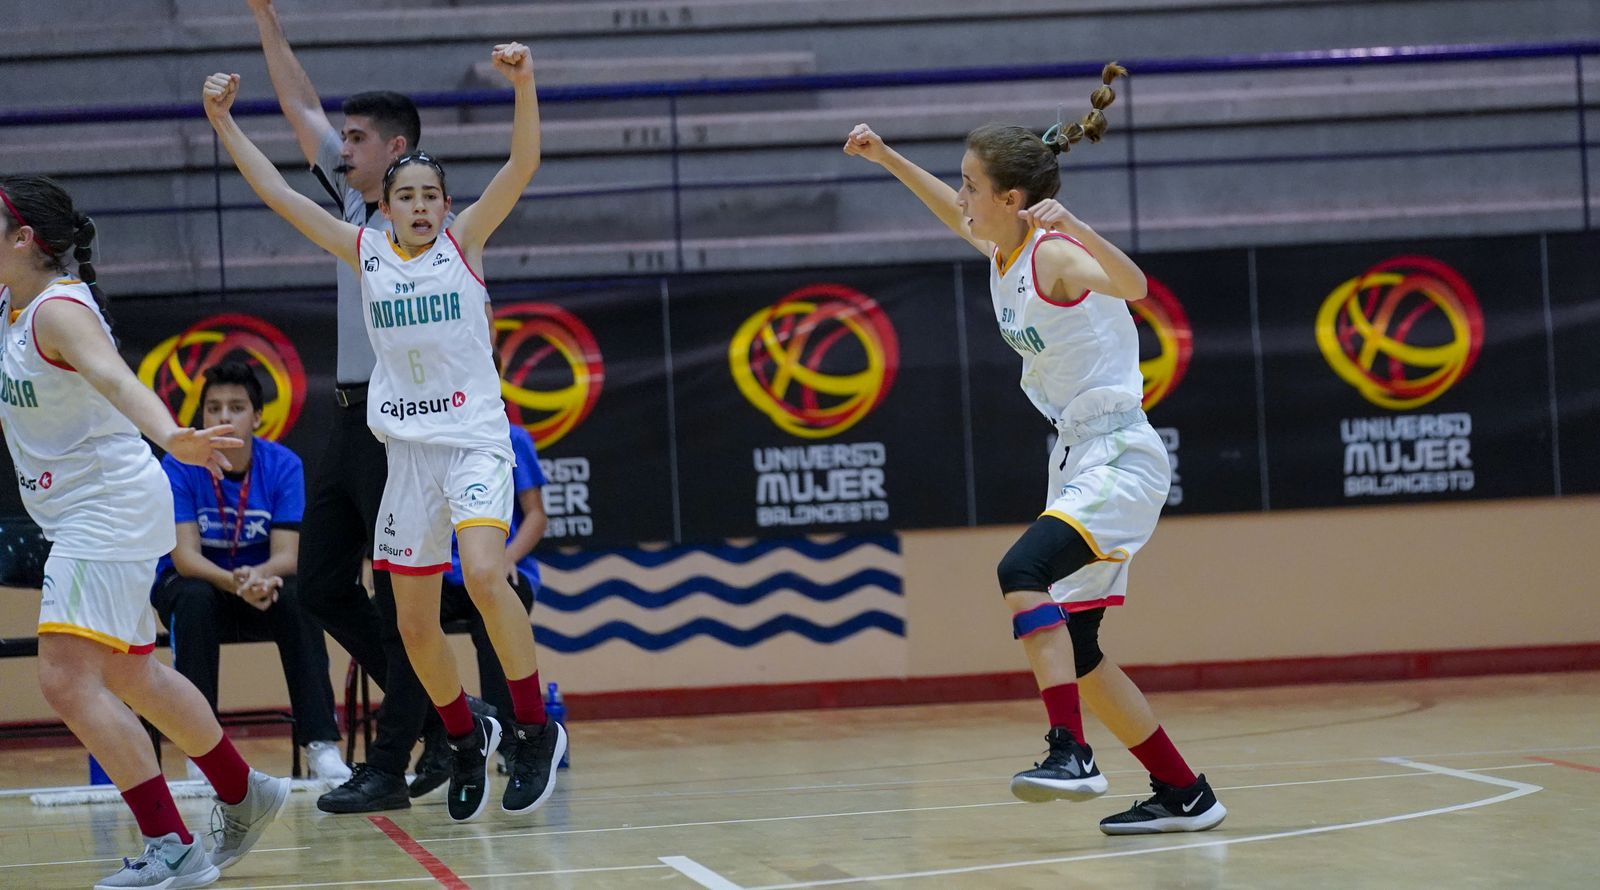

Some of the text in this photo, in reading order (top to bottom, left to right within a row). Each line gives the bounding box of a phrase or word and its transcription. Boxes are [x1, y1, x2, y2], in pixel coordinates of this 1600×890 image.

[395, 282, 416, 294] SOY
[408, 349, 426, 385] 6
[380, 398, 450, 421] cajasur
[1340, 412, 1472, 443] UNIVERSO
[753, 442, 886, 472] UNIVERSO
[1344, 438, 1473, 474] MUJER
[756, 467, 887, 504] MUJER
